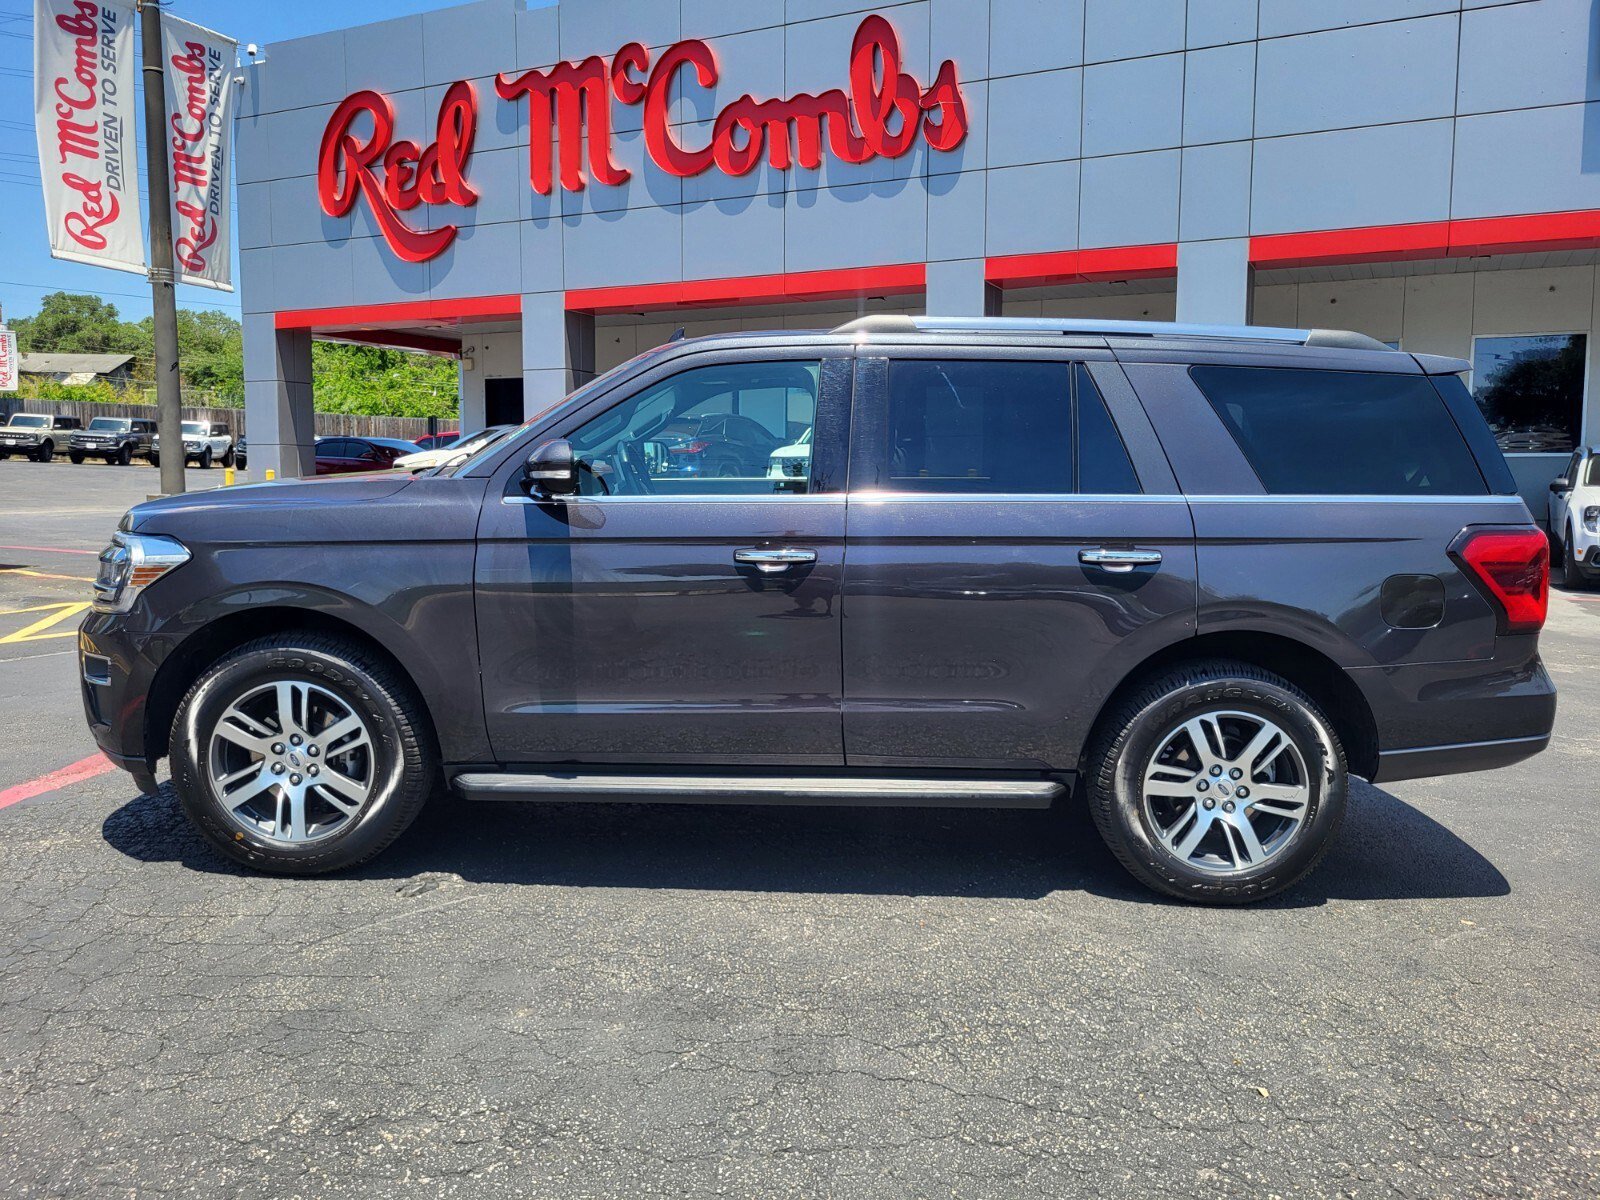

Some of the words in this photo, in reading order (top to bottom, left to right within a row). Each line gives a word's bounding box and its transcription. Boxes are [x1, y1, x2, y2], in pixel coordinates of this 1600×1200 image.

[101, 7, 117, 75] SERVE
[208, 46, 222, 108] SERVE
[54, 0, 99, 164] McCombs
[101, 78, 118, 107] TO
[171, 41, 208, 193] McCombs
[103, 112, 122, 192] DRIVEN
[208, 112, 222, 138] TO
[317, 80, 479, 263] Red
[495, 14, 968, 195] McCombs
[62, 172, 120, 250] Red
[208, 146, 223, 216] DRIVEN
[175, 200, 218, 272] Red
